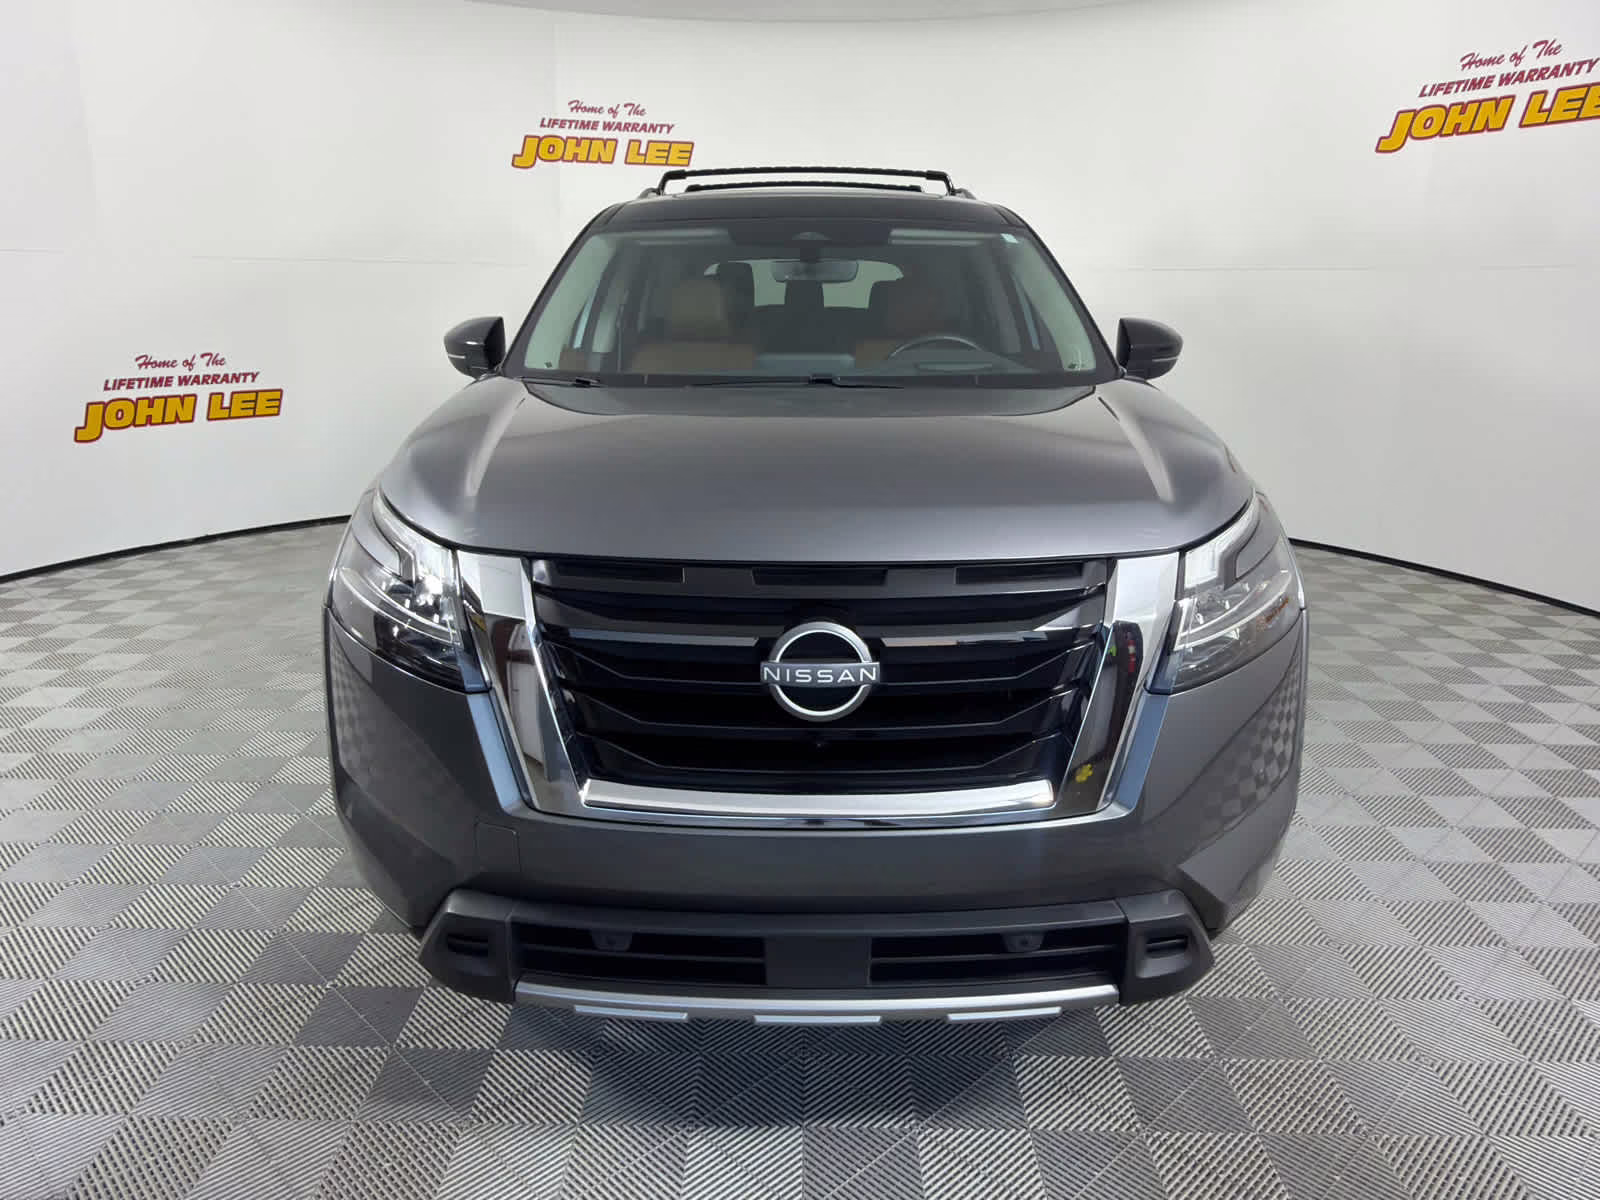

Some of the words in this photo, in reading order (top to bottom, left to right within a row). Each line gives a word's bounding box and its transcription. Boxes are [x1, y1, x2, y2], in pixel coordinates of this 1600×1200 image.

[1460, 53, 1505, 71] Home
[1509, 45, 1528, 66] of
[1532, 39, 1562, 59] The
[1418, 74, 1496, 98] LIFETIME
[1498, 58, 1600, 87] WARRANTY
[568, 100, 605, 113] Home
[607, 104, 621, 119] of
[623, 103, 647, 116] The
[539, 117, 600, 131] LIFETIME
[602, 120, 675, 134] WARRANTY
[1375, 95, 1516, 153] JOHN
[512, 135, 618, 169] JOHN
[624, 139, 695, 167] LEE
[135, 355, 178, 370] Home
[182, 355, 196, 371] of
[200, 353, 227, 368] The
[103, 376, 173, 391] LIFETIME
[177, 371, 260, 387] WARRANTY
[74, 393, 197, 443] JOHN
[206, 388, 283, 421] LEE
[763, 666, 877, 683] NISSAN
